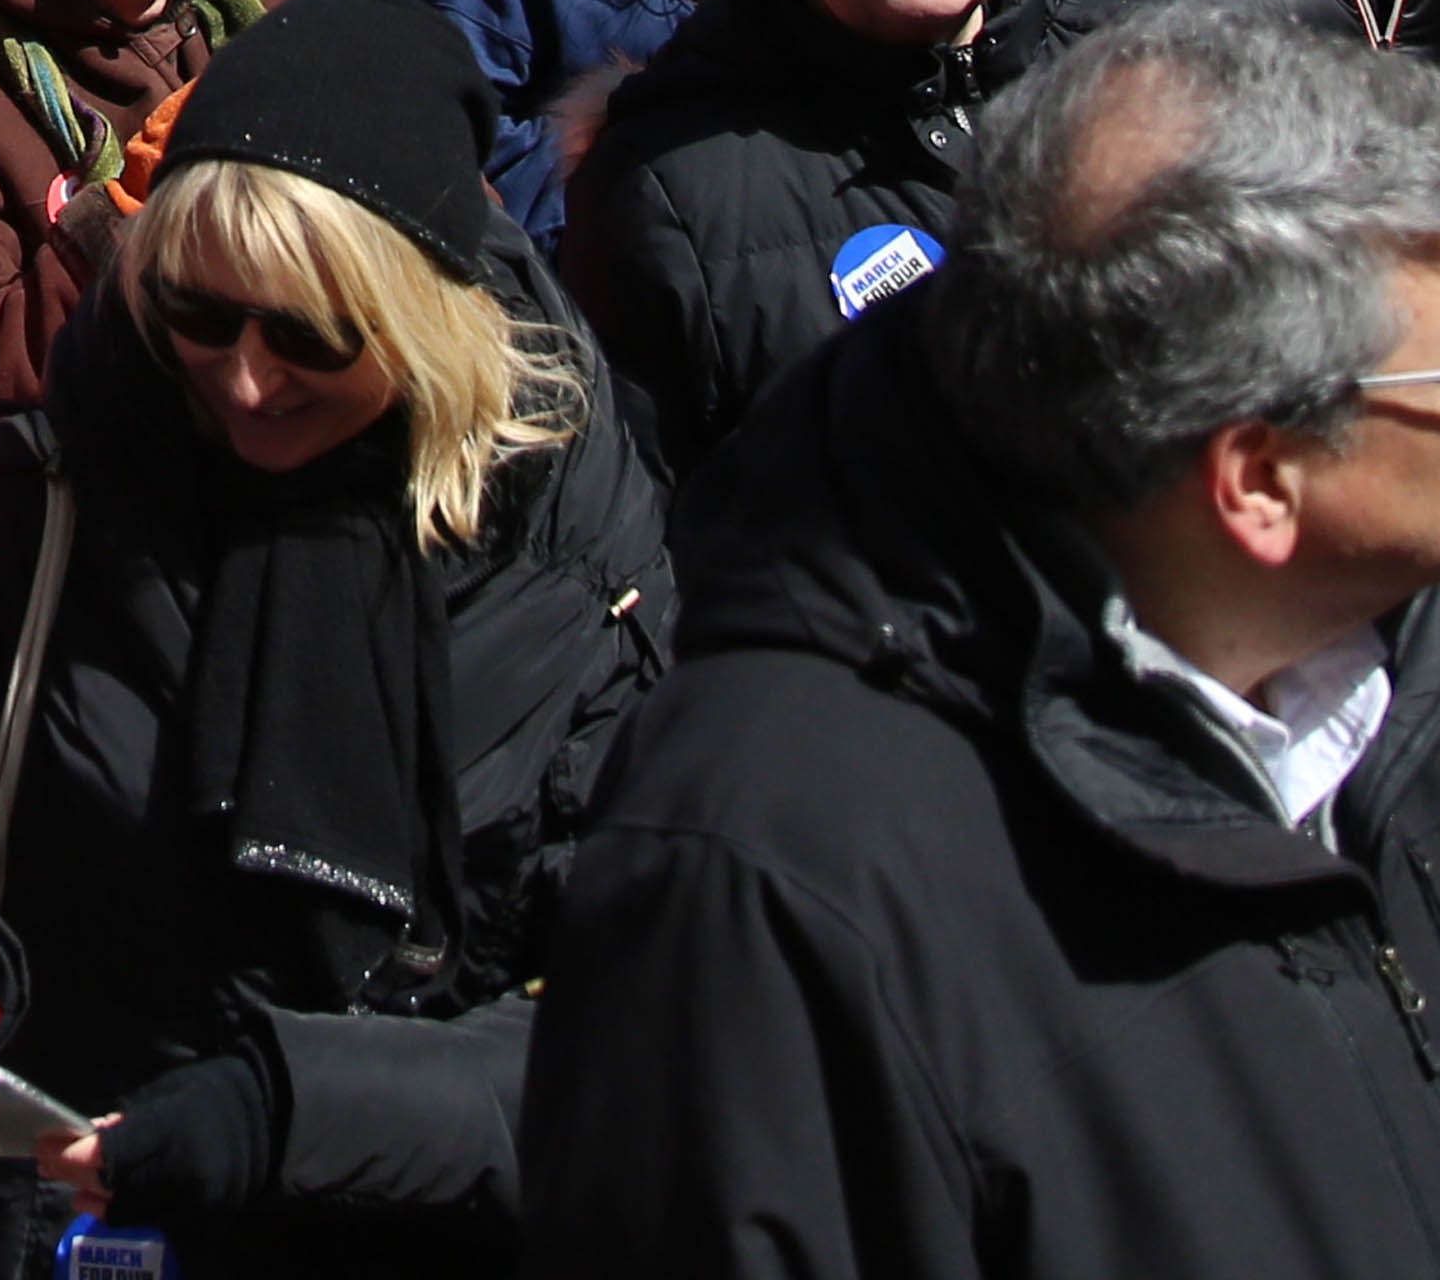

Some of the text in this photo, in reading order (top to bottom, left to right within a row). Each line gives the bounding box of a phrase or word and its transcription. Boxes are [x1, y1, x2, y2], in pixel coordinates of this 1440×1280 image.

[851, 249, 904, 295] MARCH
[861, 256, 925, 307] FOR OUR
[77, 1243, 144, 1268] MARCH
